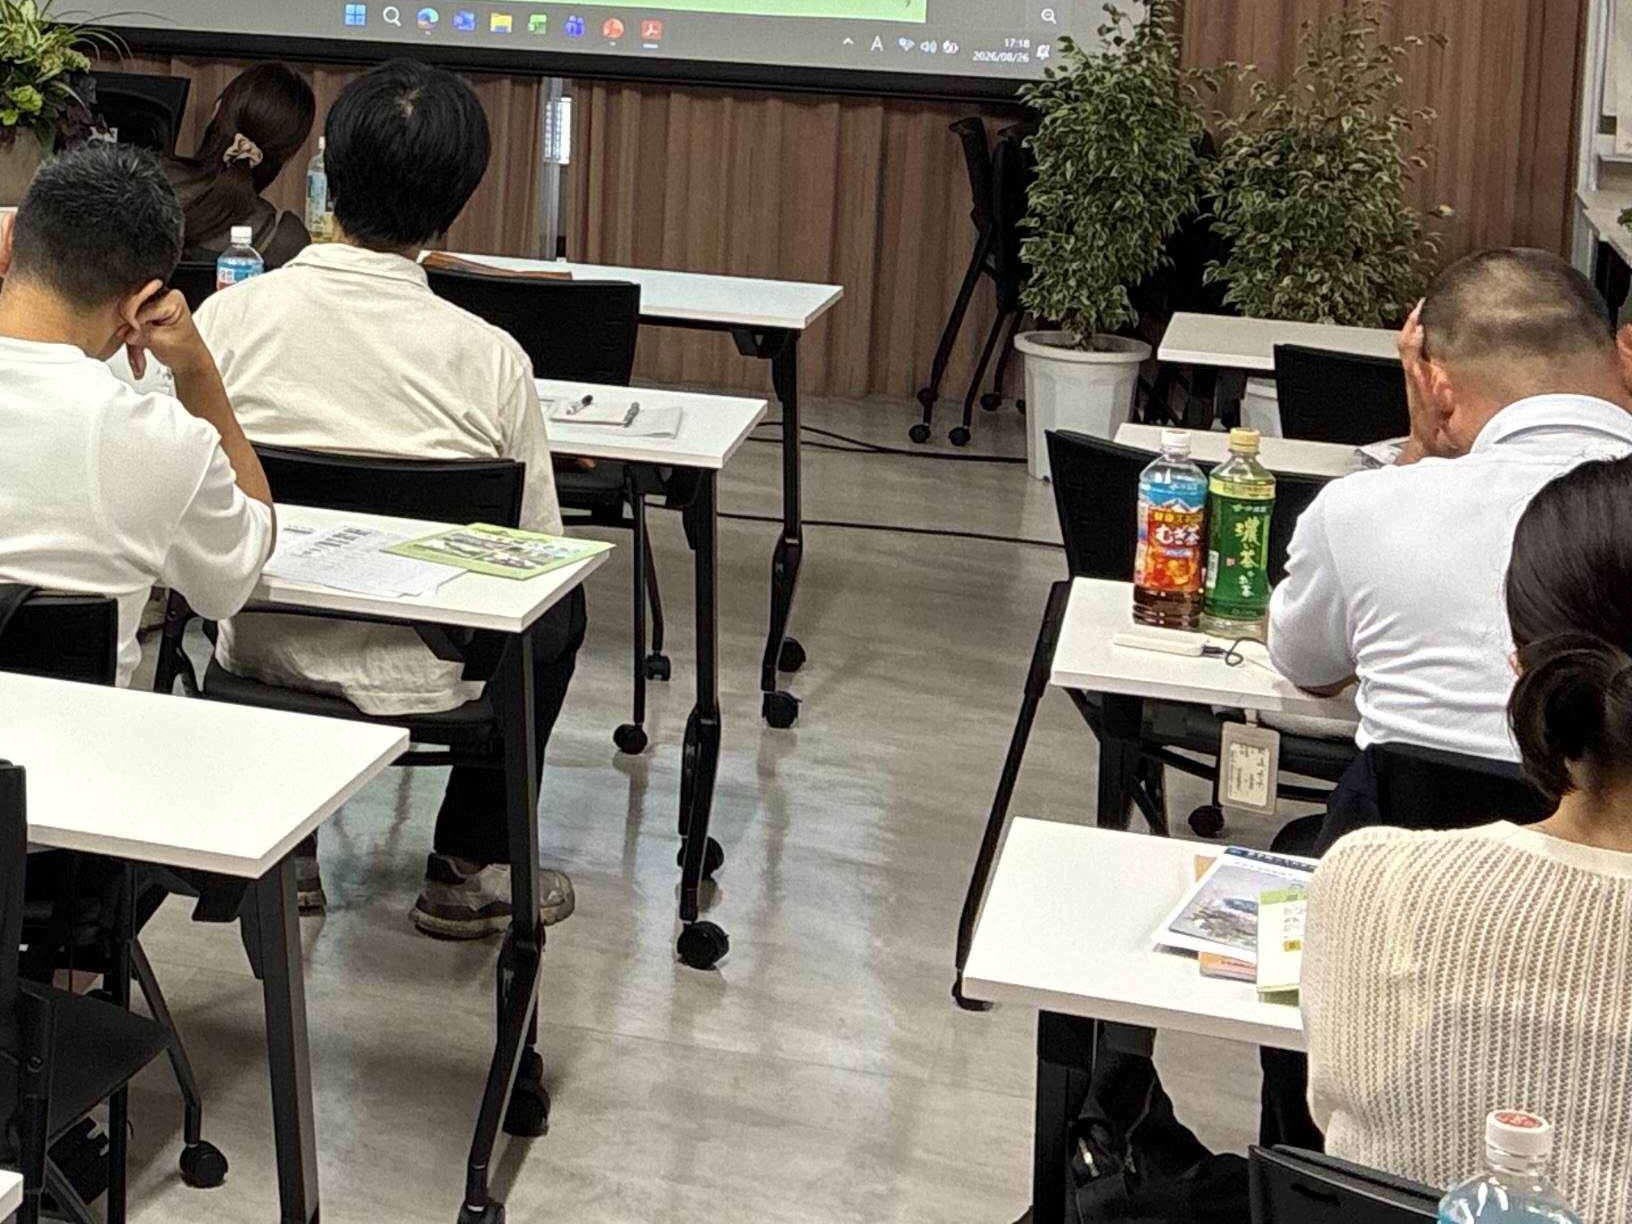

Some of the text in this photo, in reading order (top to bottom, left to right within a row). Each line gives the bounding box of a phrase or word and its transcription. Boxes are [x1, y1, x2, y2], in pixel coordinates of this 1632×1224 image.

[1004, 38, 1030, 49] 17:18
[1155, 523, 1201, 546] むぎ茶
